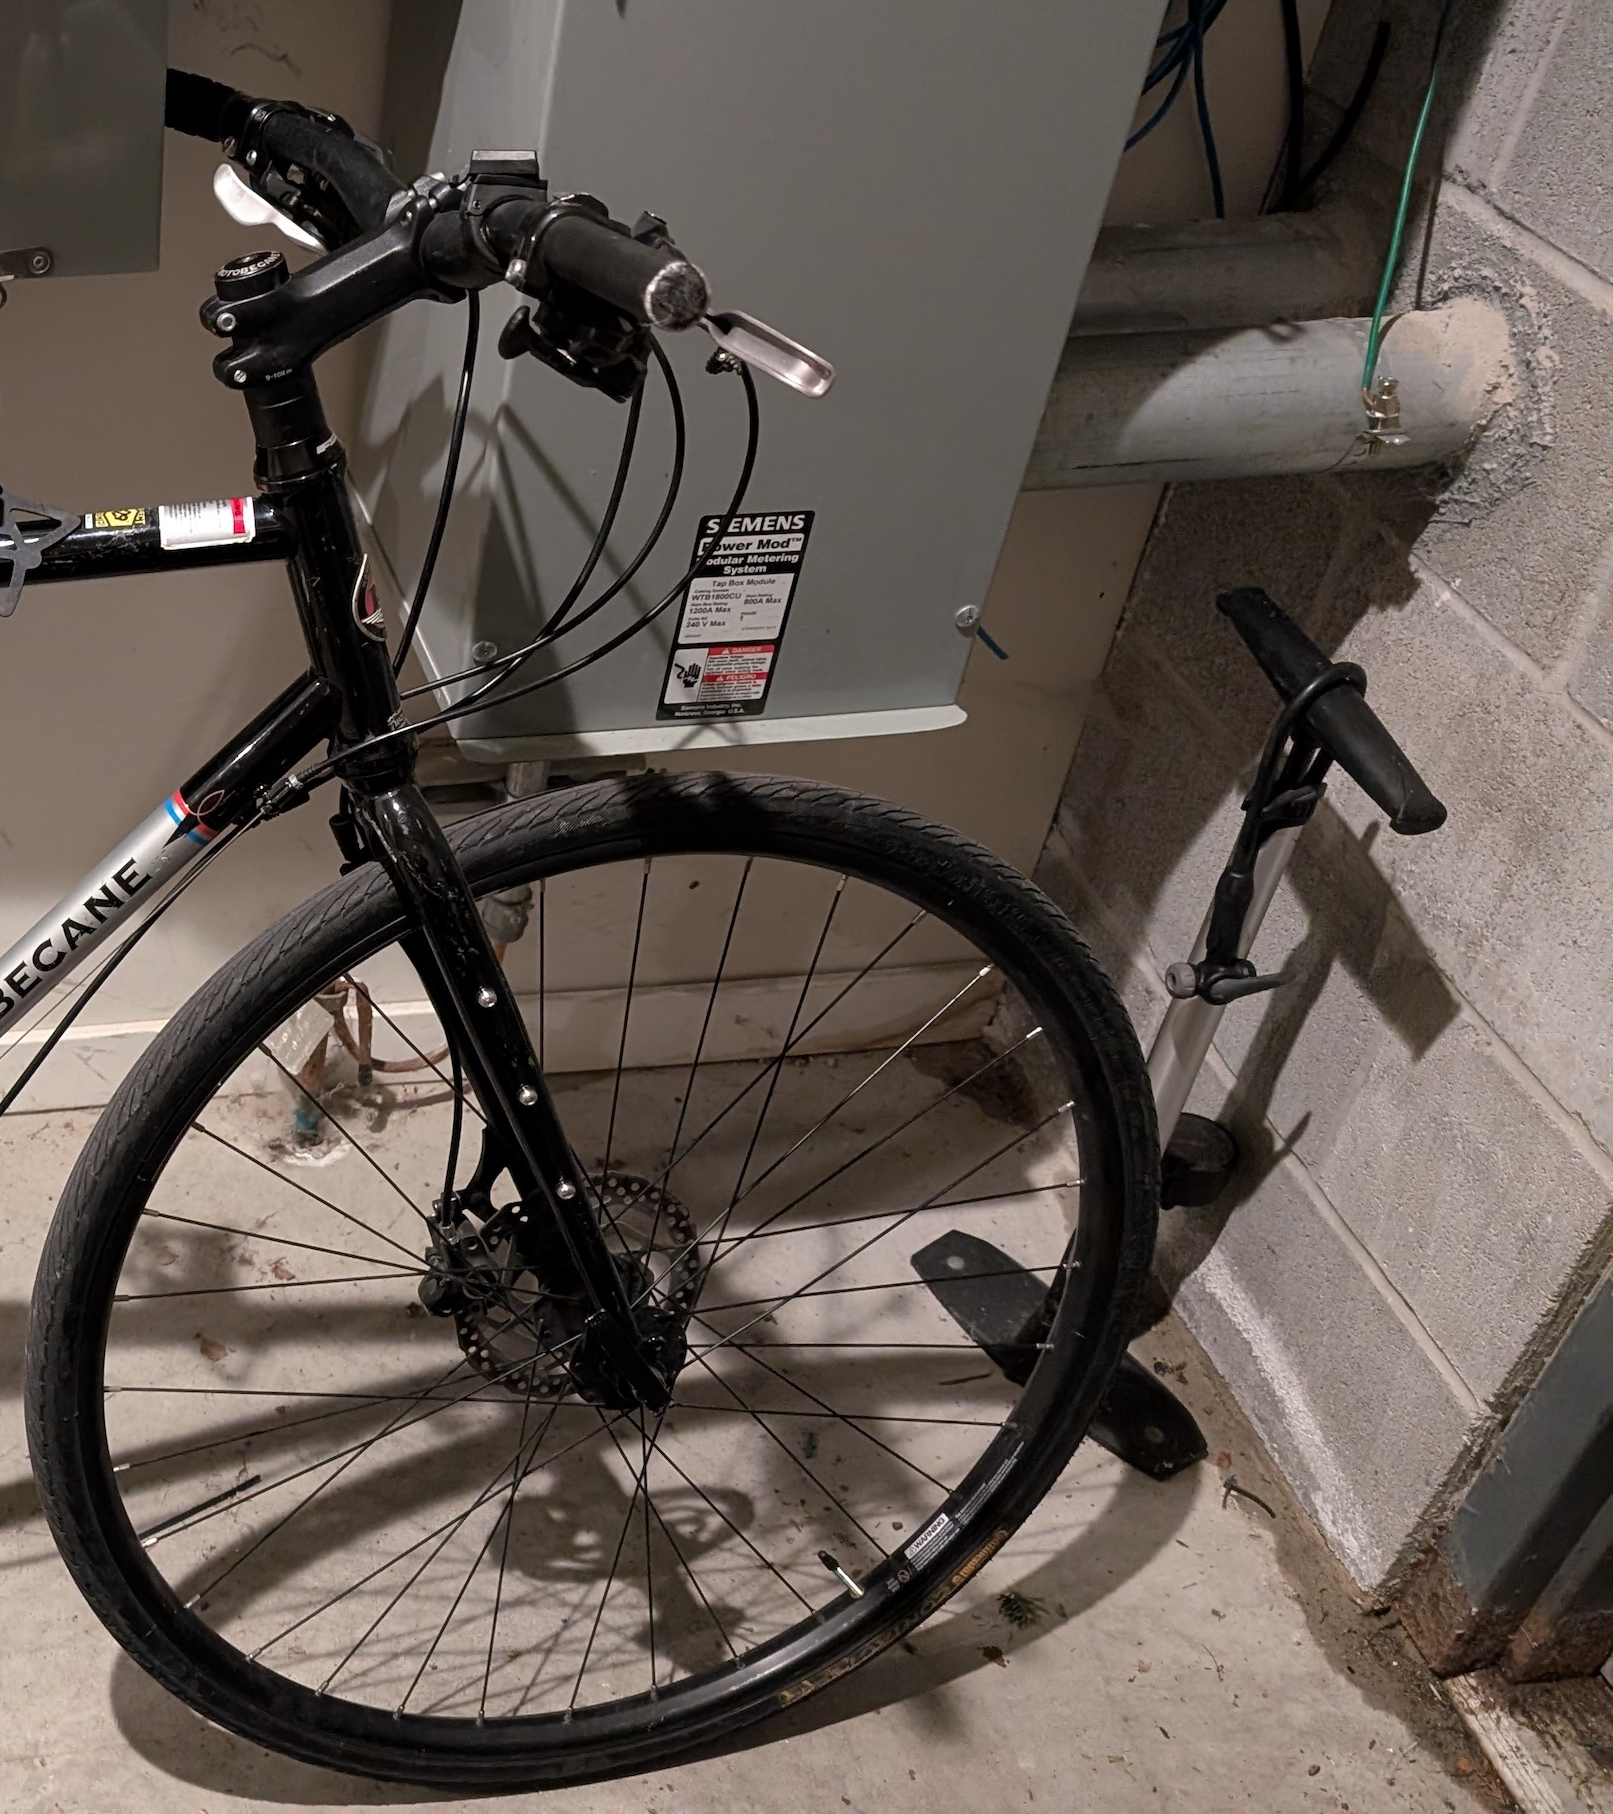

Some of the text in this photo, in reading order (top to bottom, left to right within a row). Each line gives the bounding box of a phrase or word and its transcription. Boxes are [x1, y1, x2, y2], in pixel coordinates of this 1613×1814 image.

[706, 514, 806, 534] SEMENS
[697, 554, 800, 566] odular Metering
[722, 564, 767, 575] System
[913, 1516, 947, 1550] WARNING
